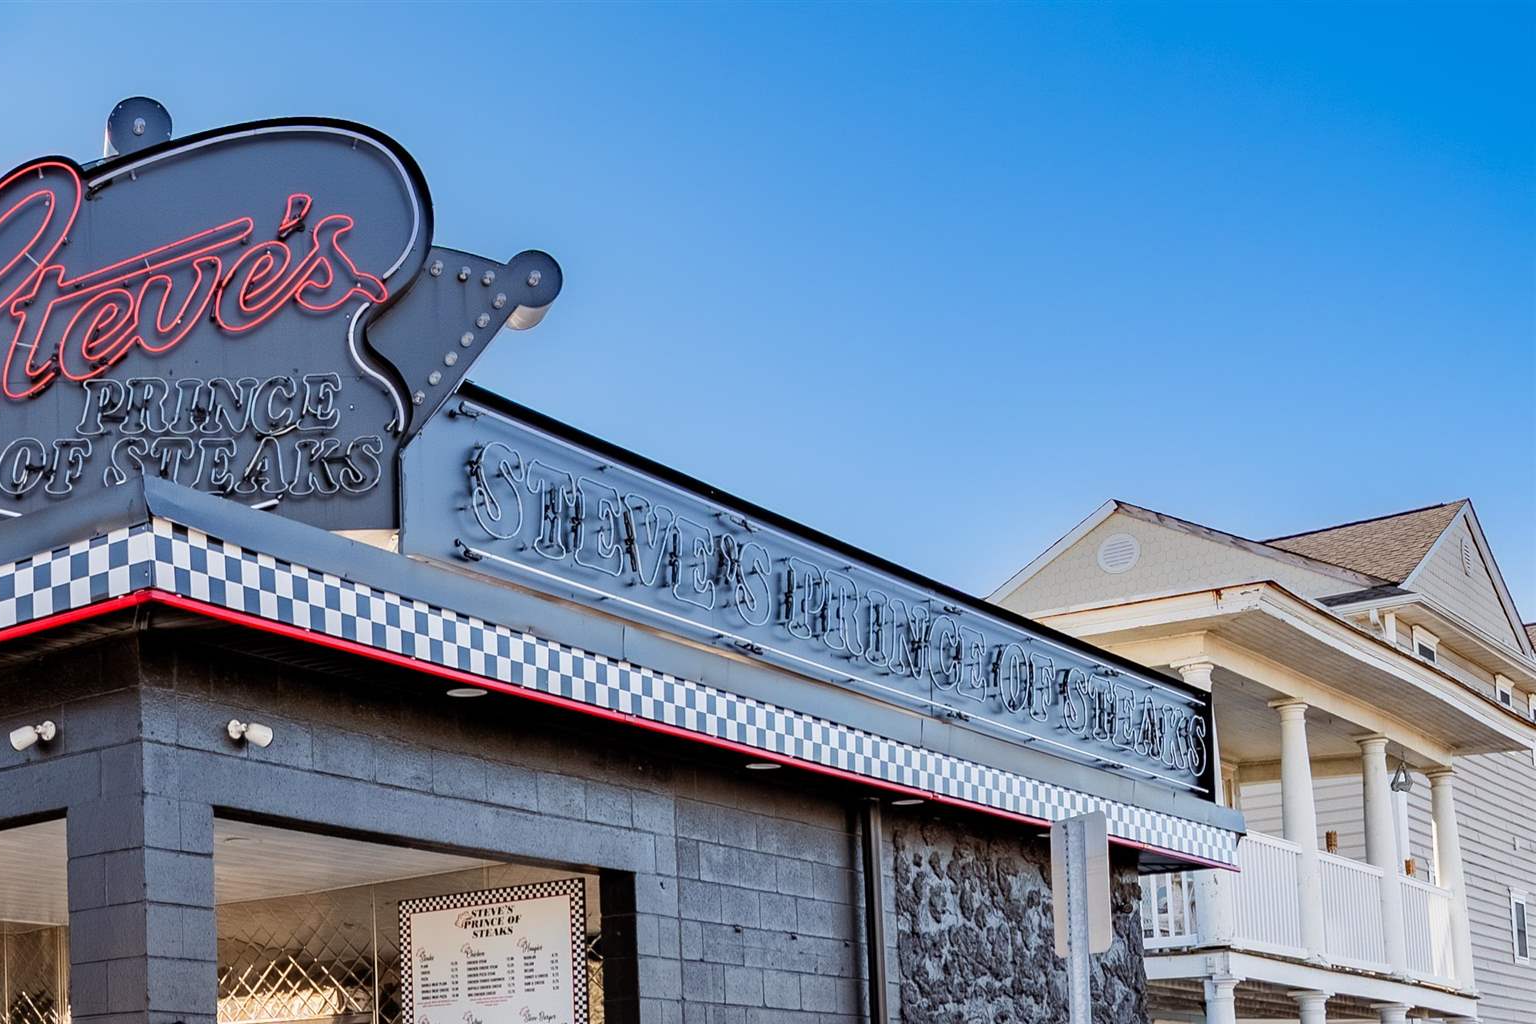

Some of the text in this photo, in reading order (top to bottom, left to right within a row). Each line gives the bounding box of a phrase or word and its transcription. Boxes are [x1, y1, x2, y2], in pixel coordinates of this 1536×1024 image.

[75, 371, 343, 436] PRINCE
[105, 435, 383, 496] STEAKS
[470, 441, 1208, 779] STEVE'S PRINCE OF STEAKS
[464, 915, 522, 929] PRINCE OF
[471, 904, 515, 918] STEVE'S
[472, 926, 513, 939] STEAKS
